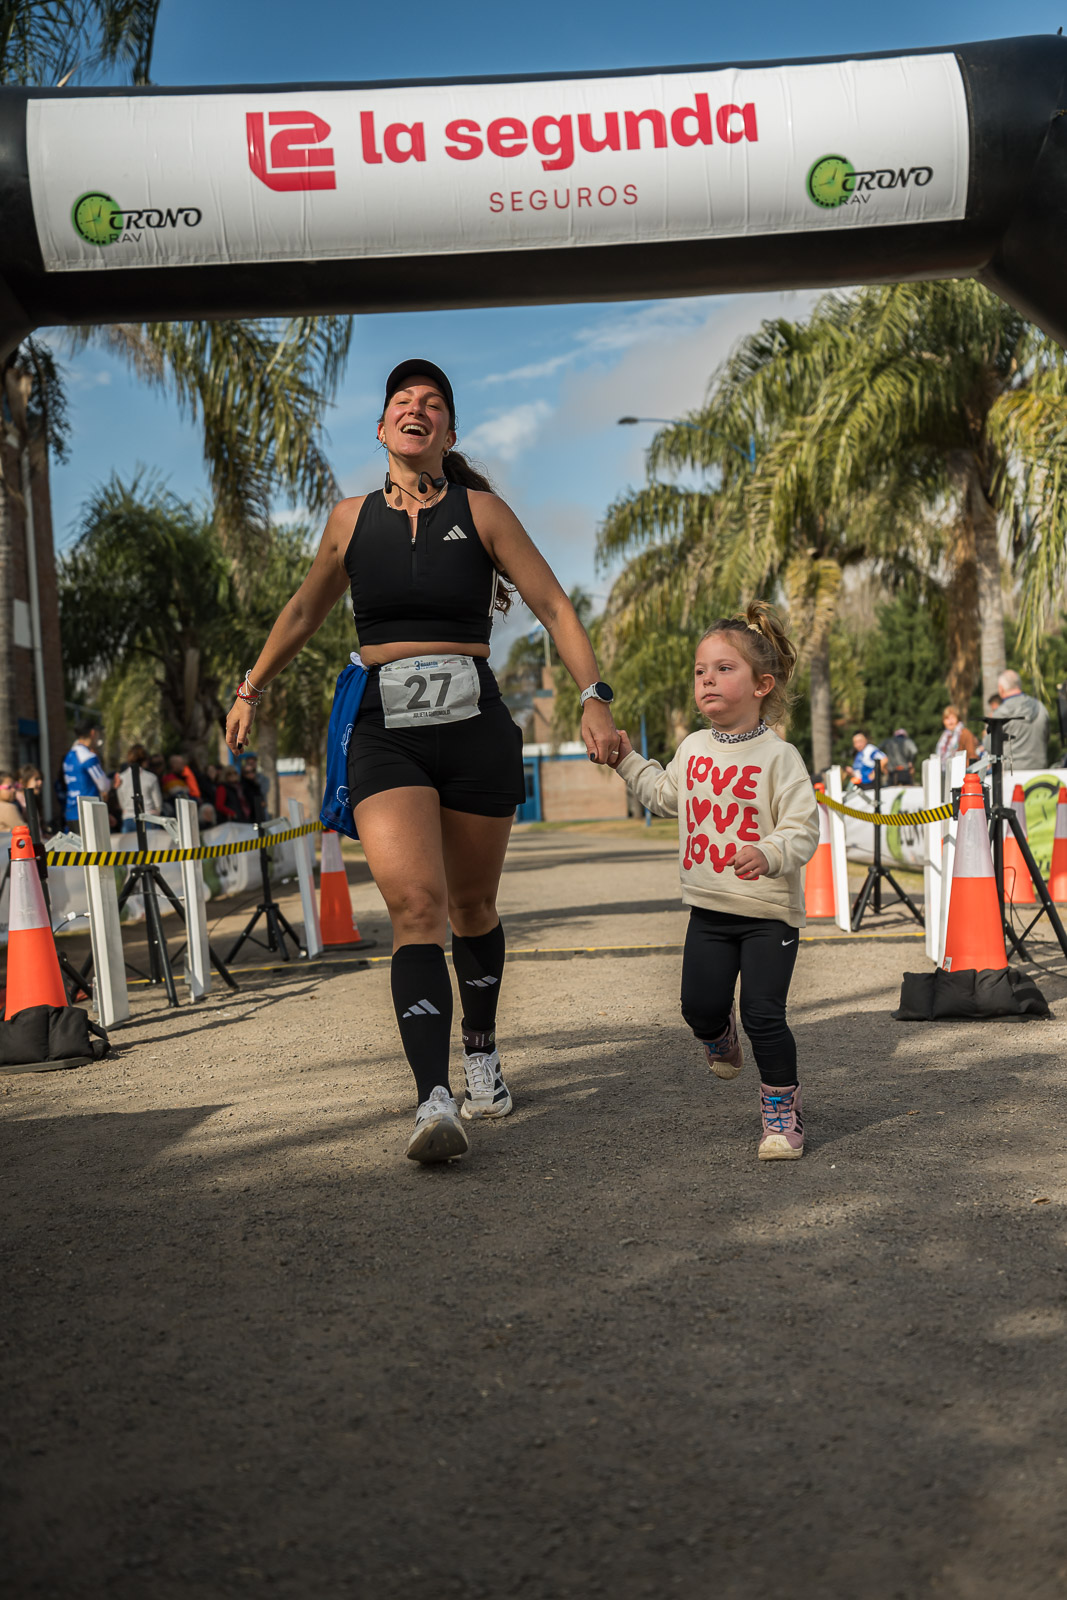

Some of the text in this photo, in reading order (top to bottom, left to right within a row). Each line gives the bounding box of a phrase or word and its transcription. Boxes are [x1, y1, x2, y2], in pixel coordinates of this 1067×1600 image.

[360, 93, 759, 172] la segunda
[842, 166, 934, 192] CRONO
[489, 184, 638, 213] SEGUROS
[839, 193, 872, 206] RAV
[109, 207, 202, 231] CRONO
[109, 232, 142, 243] RAV
[404, 672, 452, 710] 27
[686, 755, 762, 800] LOVE
[683, 833, 759, 880] LOV
